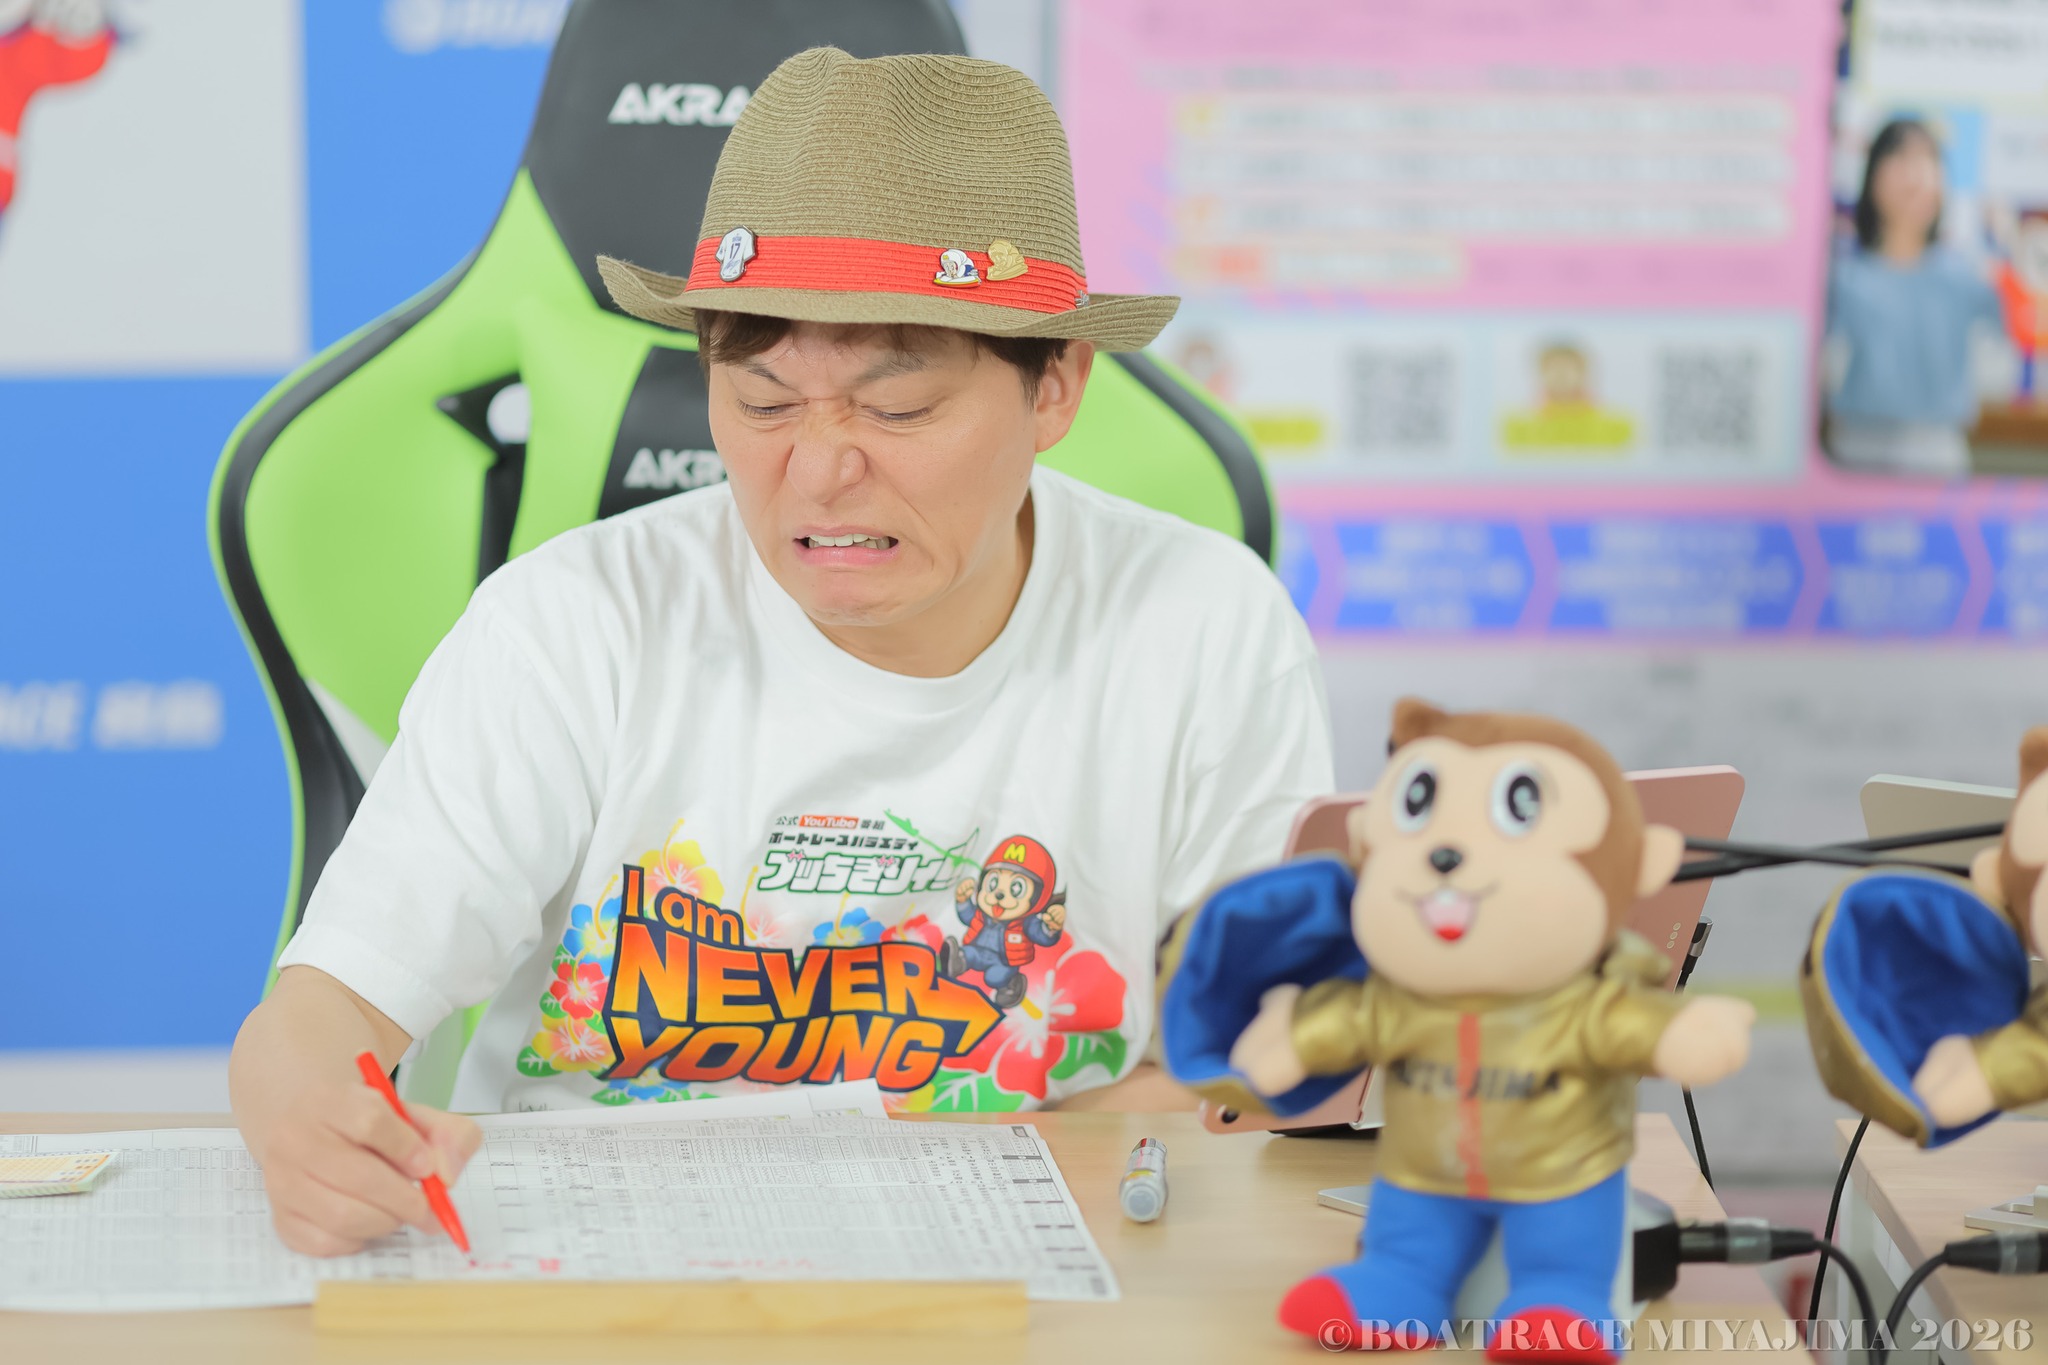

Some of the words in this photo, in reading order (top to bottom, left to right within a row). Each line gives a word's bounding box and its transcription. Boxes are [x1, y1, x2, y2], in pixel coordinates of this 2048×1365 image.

[729, 242, 741, 260] 17
[801, 816, 857, 829] YouTube
[1003, 842, 1026, 864] M
[624, 869, 644, 917] I
[659, 890, 741, 945] am
[610, 922, 955, 1023] NEVER
[608, 1014, 945, 1090] YOUNG
